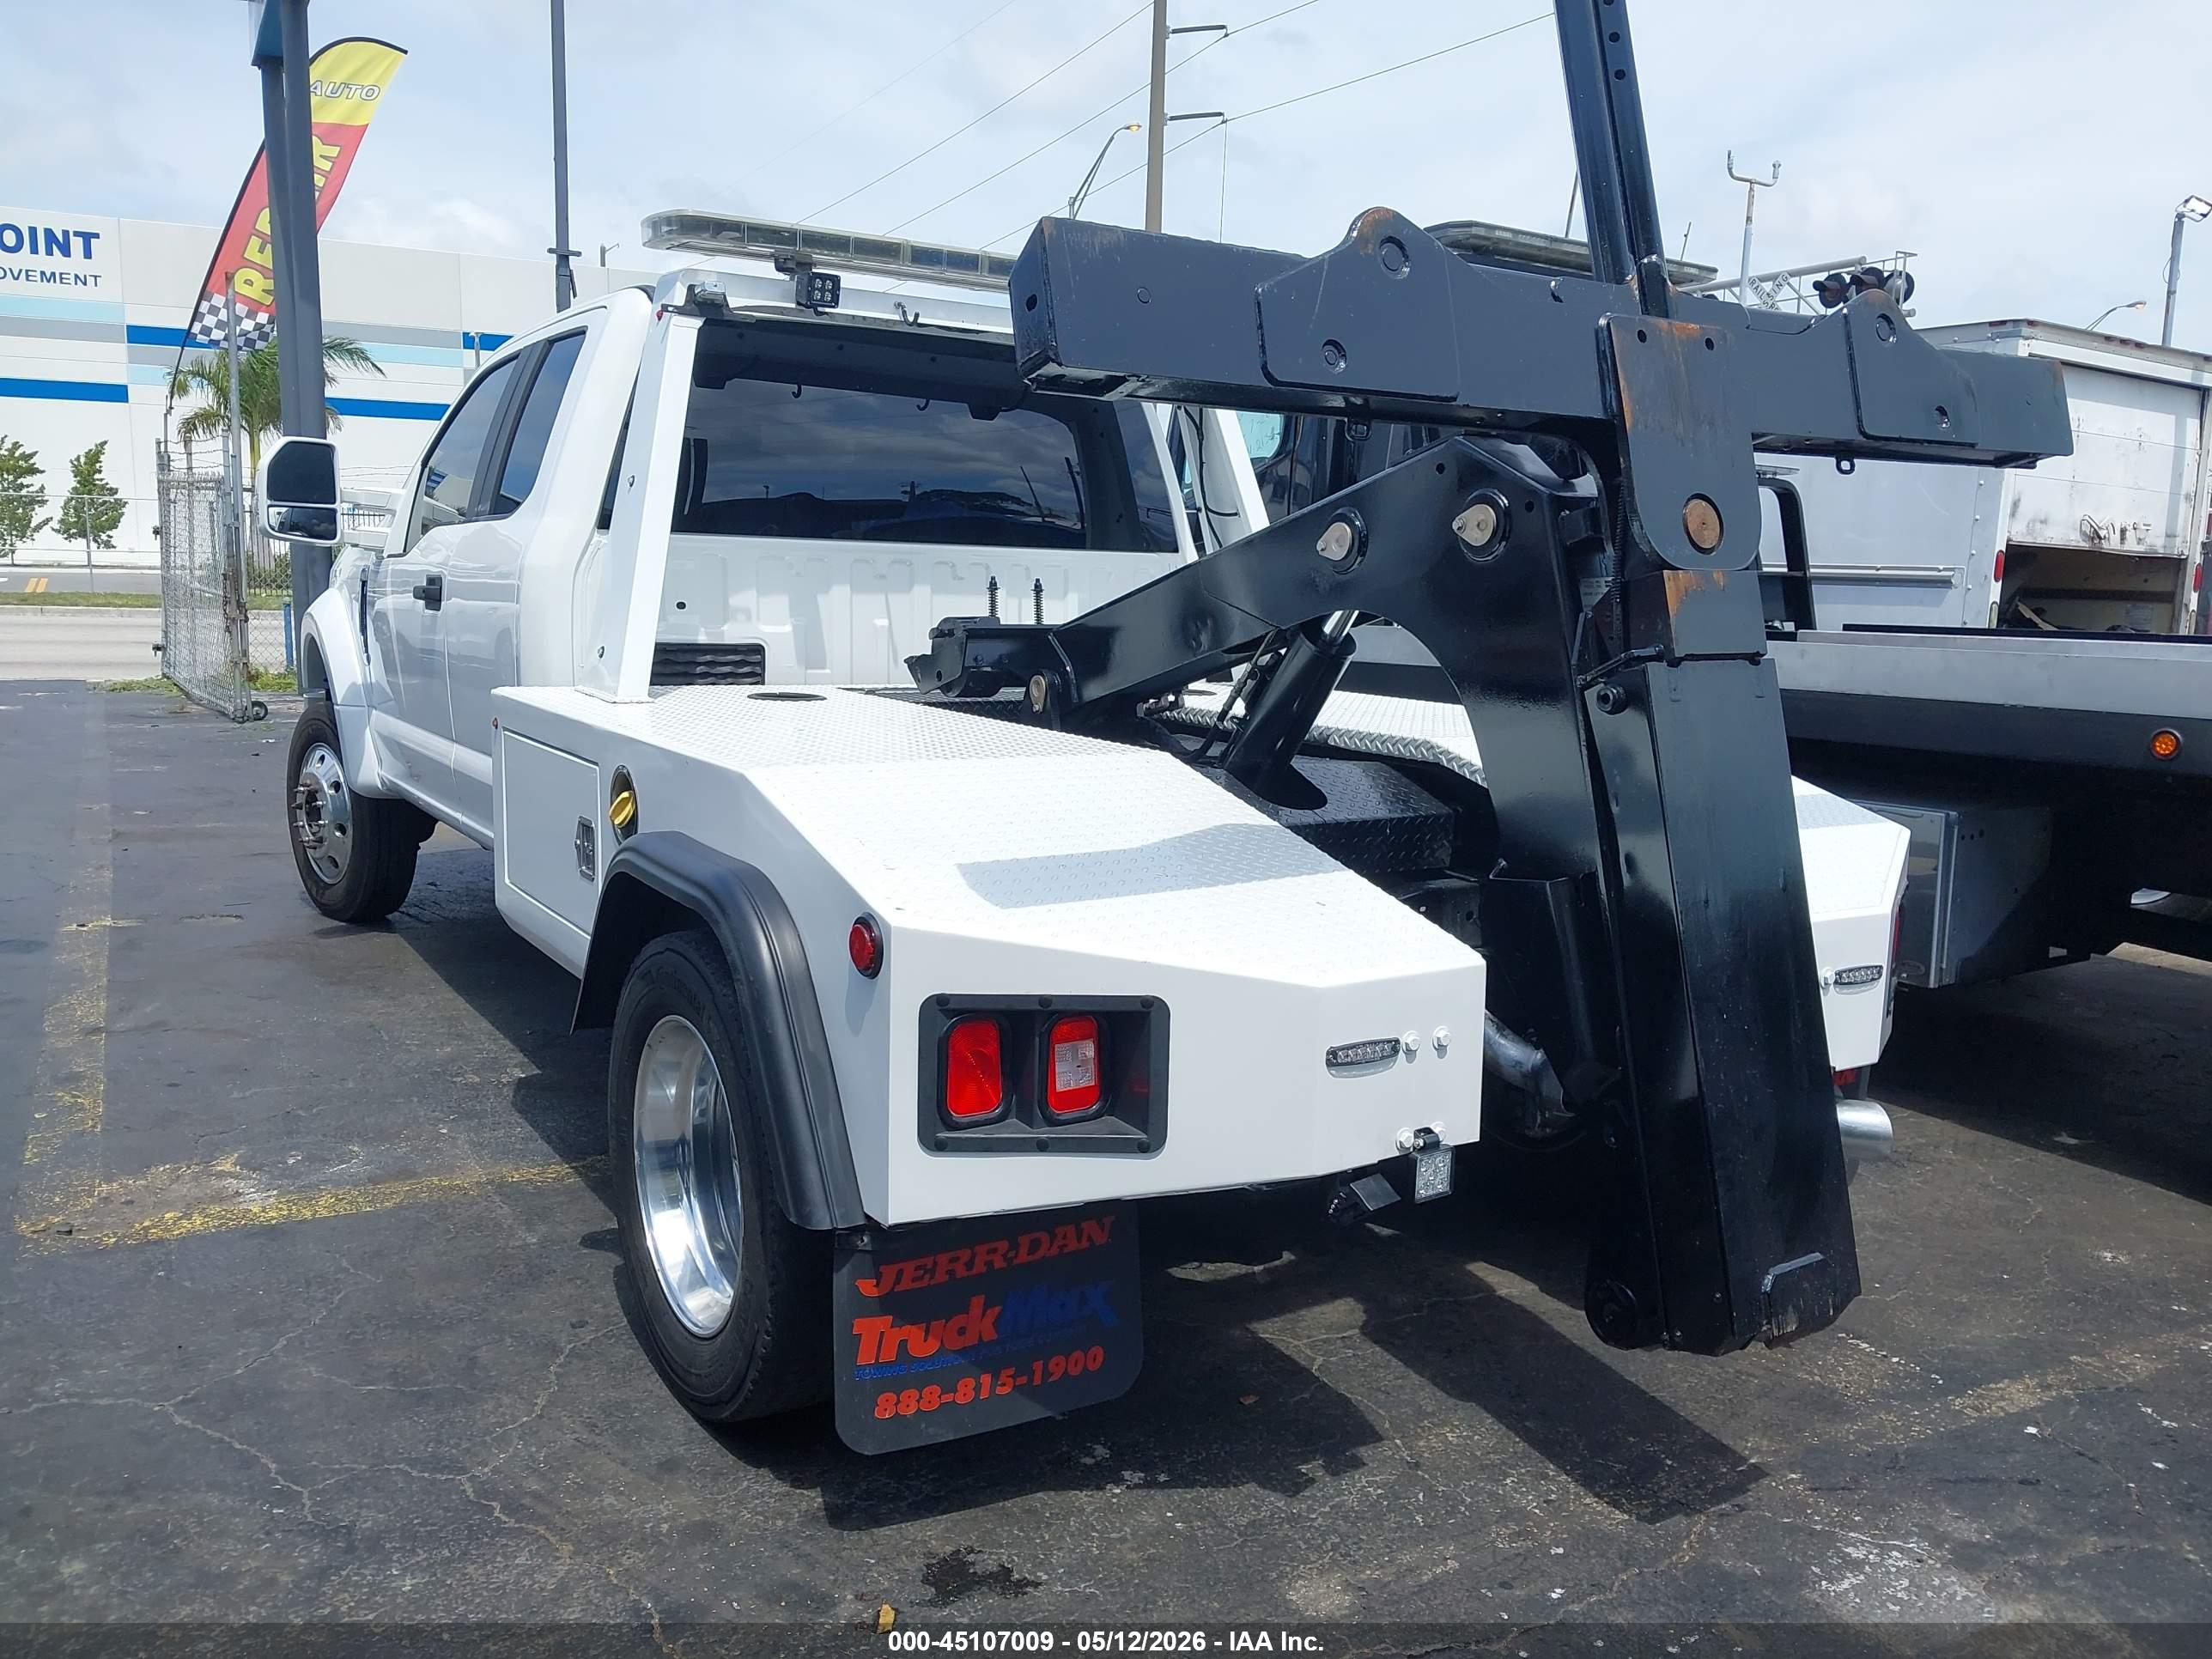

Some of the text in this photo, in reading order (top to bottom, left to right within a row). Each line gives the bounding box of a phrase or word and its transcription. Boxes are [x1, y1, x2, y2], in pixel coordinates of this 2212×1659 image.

[310, 80, 380, 100] AUTO
[0, 223, 100, 260] OINT
[873, 1345, 1106, 1420] 888-815-1900
